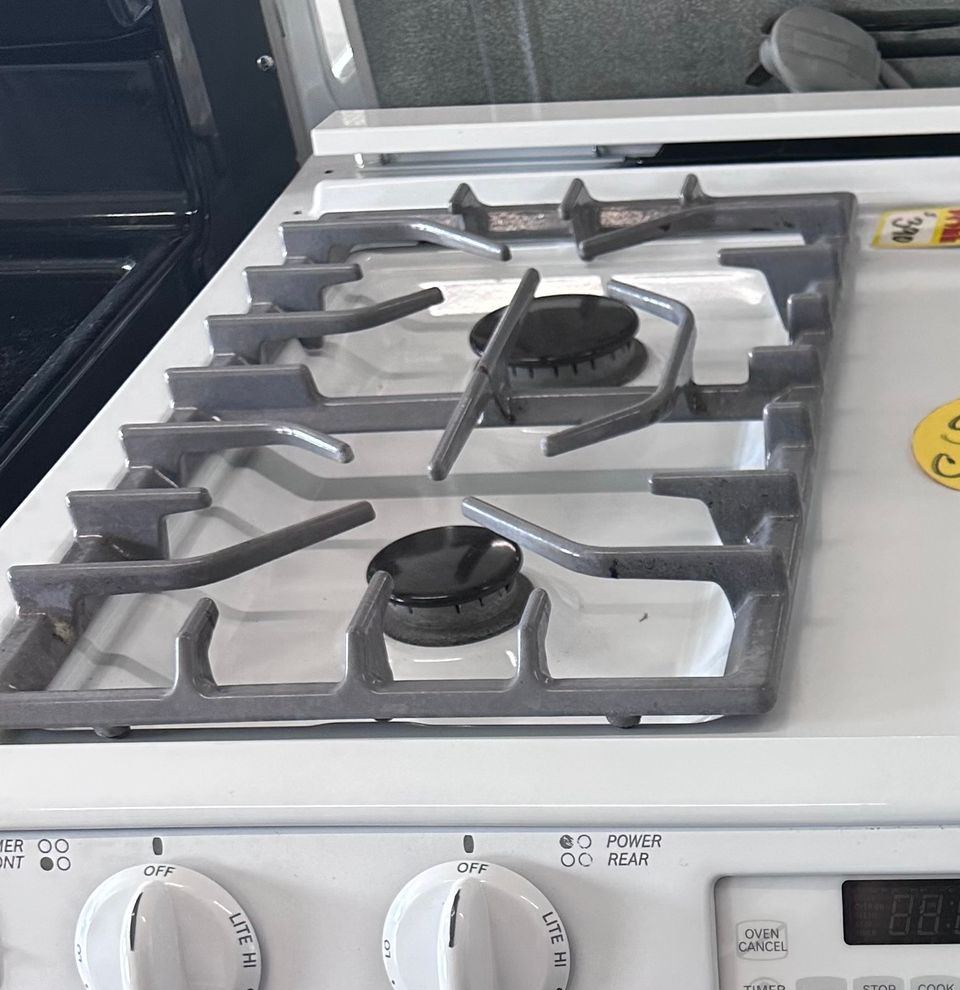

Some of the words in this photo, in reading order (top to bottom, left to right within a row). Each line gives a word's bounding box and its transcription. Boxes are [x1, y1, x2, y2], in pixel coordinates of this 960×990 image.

[606, 834, 662, 849] POWER
[607, 852, 649, 866] REAR
[143, 865, 176, 877] OFF
[457, 862, 489, 875] OFF
[229, 912, 254, 946] LITE
[242, 952, 257, 968] HI
[541, 911, 565, 945] LITE
[554, 951, 567, 967] HI
[744, 928, 780, 941] OVEN
[383, 939, 391, 959] LO
[737, 940, 788, 953] CANCEL
